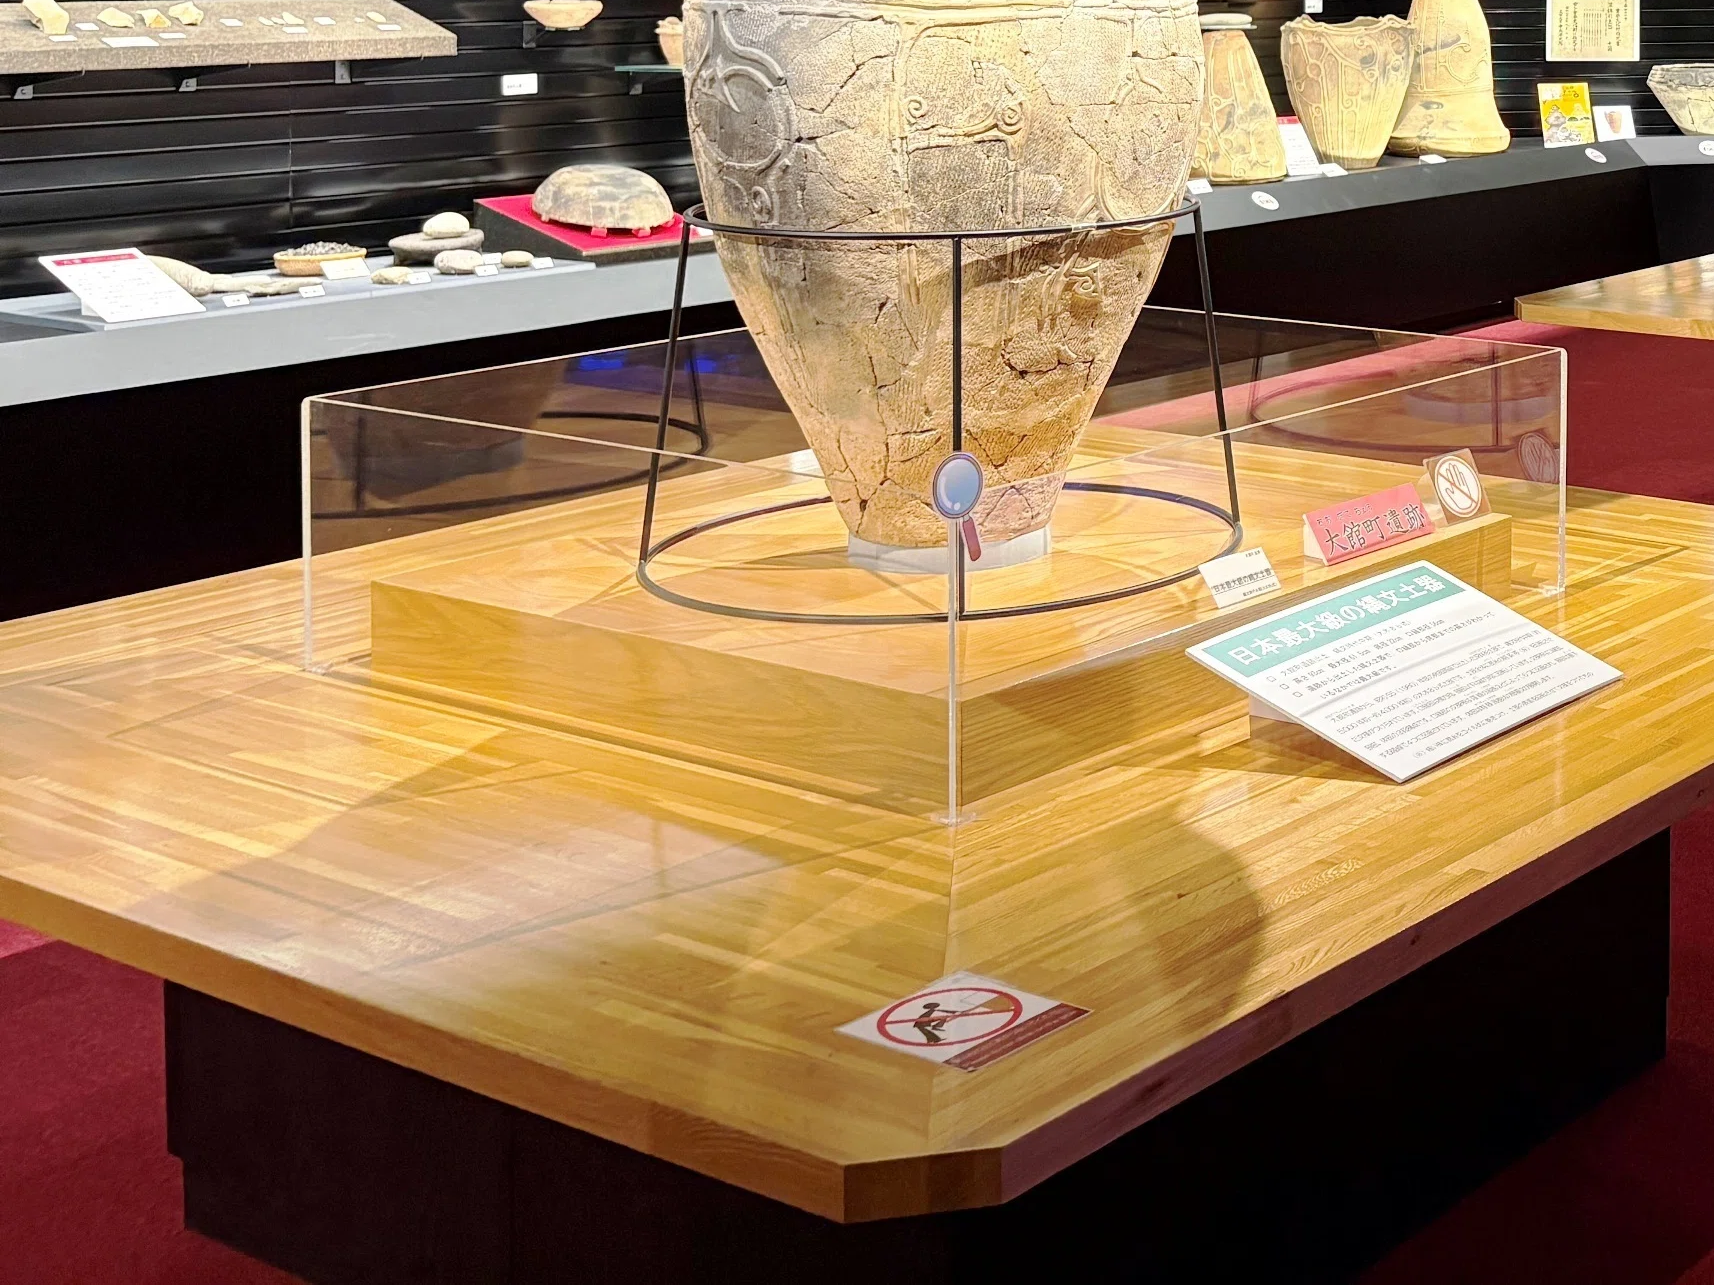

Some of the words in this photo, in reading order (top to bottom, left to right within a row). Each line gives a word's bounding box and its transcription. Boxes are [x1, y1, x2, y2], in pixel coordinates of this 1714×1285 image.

[1325, 504, 1425, 555] 大館町遺跡
[1228, 575, 1445, 665] 日本最大級の縄文土器
